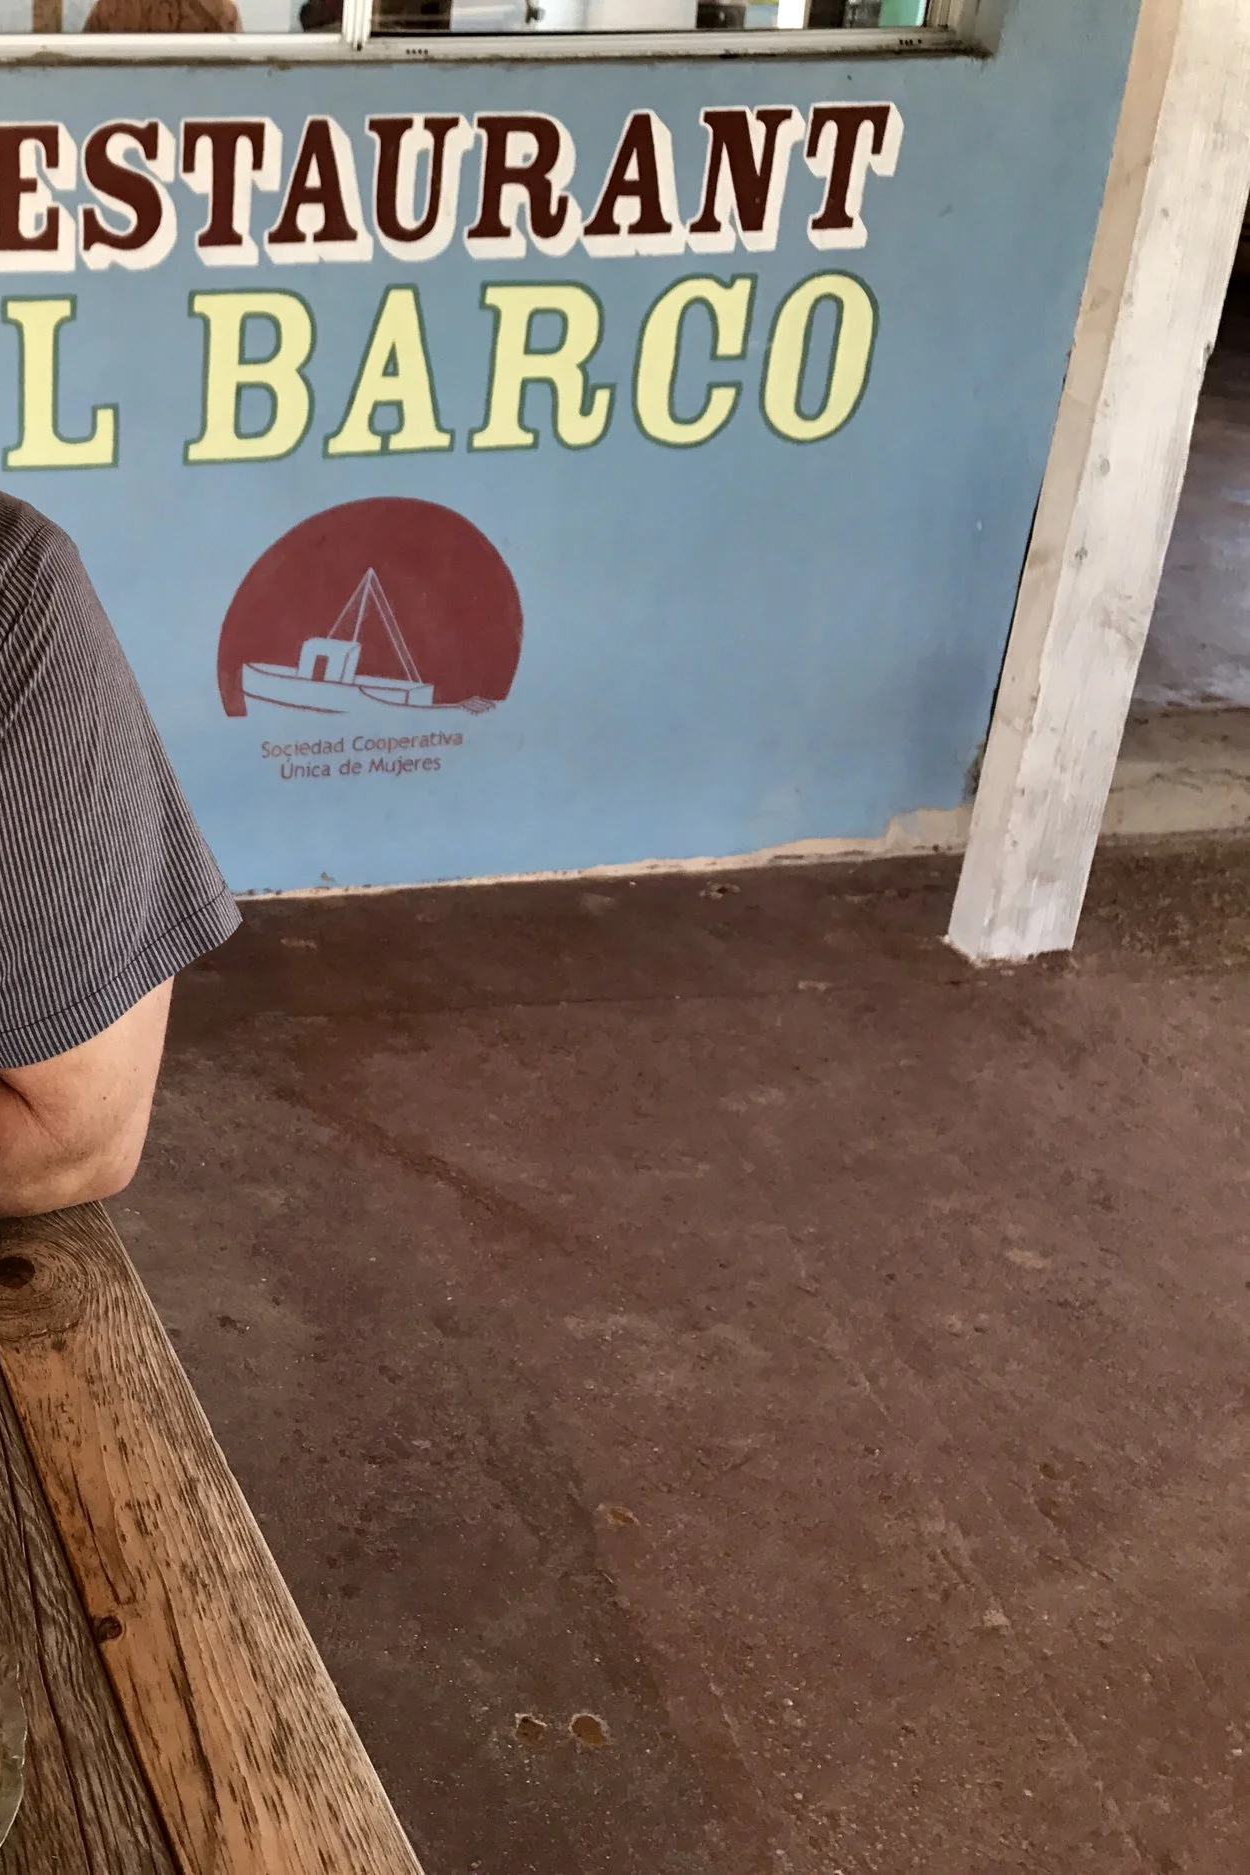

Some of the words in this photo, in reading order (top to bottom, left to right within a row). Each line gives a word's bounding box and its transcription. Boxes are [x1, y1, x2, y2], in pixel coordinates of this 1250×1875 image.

[183, 271, 879, 464] BARCO
[261, 736, 345, 759] Sociedad
[352, 730, 464, 753] Cooperativa
[280, 757, 331, 780] Única
[338, 758, 363, 775] de
[368, 755, 442, 777] Mujeres
